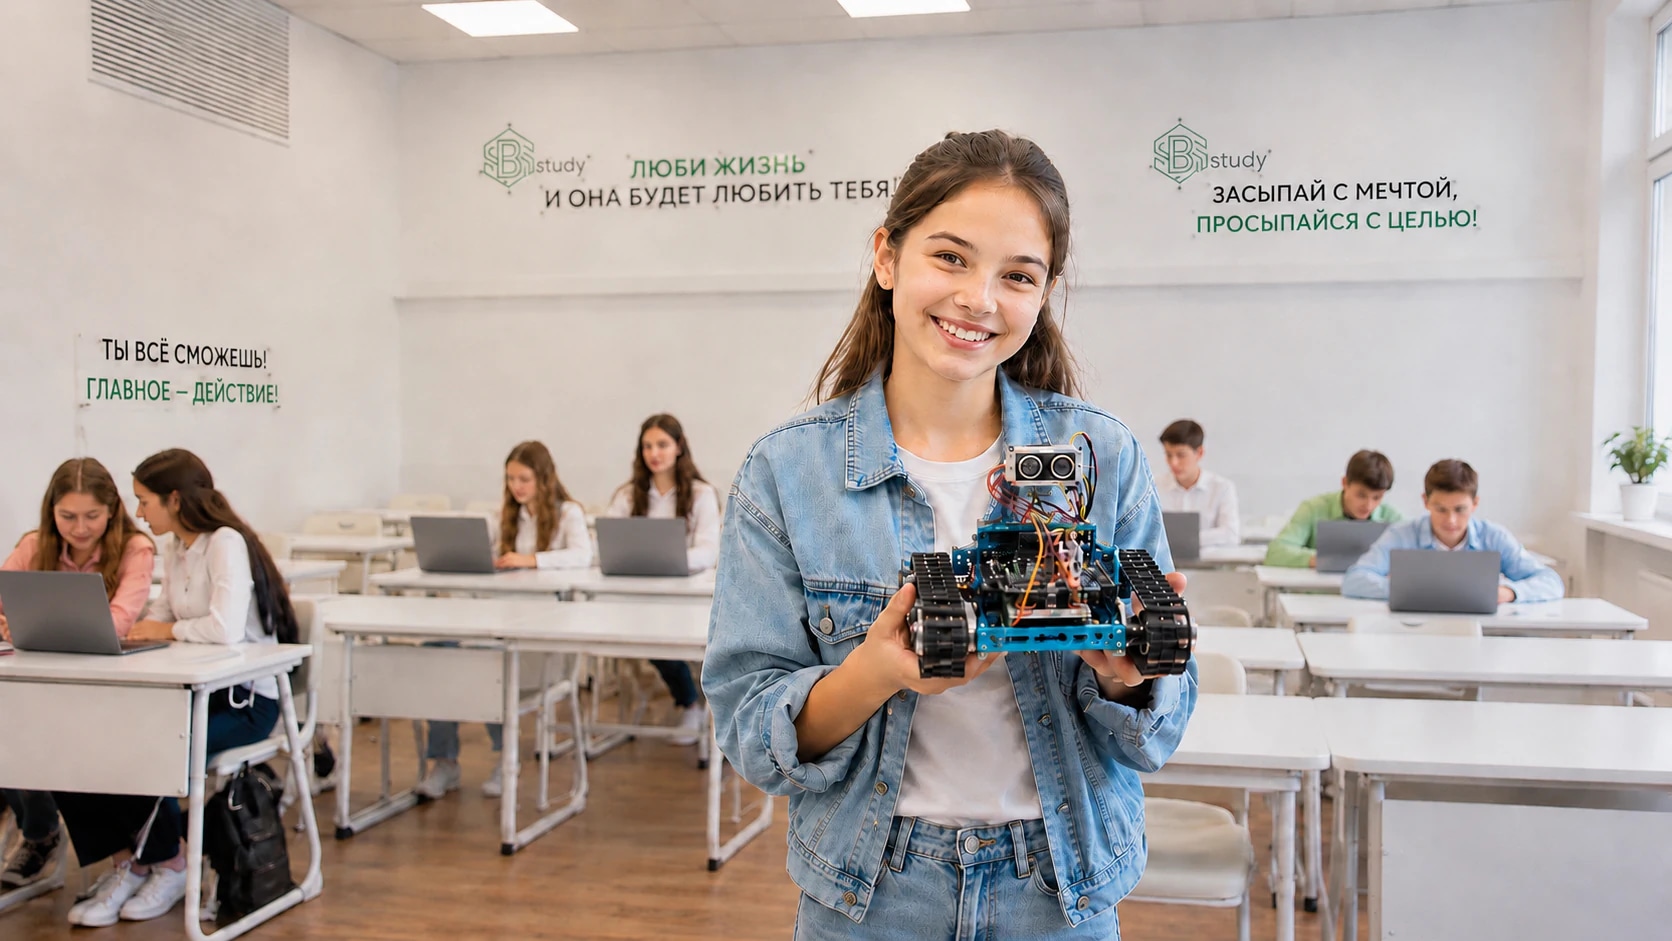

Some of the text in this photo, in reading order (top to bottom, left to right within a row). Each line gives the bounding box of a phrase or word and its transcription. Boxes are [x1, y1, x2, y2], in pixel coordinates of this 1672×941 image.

[536, 157, 586, 177] study
[630, 154, 805, 179] ЛЮБИ ЖИЗНЬ
[1210, 151, 1267, 172] study
[545, 189, 560, 208] И
[568, 189, 622, 207] ОНА
[630, 185, 706, 208] БУДЕТ
[713, 182, 822, 203] ЛЮБИТЬ
[1212, 176, 1458, 204] ЗАСЫПАЙ С МЕЧТОЙ,
[1197, 208, 1478, 233] ПРОСЫПАЙСЯ С ЦЕЛЬЮ!
[102, 338, 267, 369] ТЫ ВСЁ СМОЖЕШЬ!
[87, 377, 171, 401] ГЛАВНОЕ
[192, 378, 279, 406] ДЕЙСТВИЕ!
